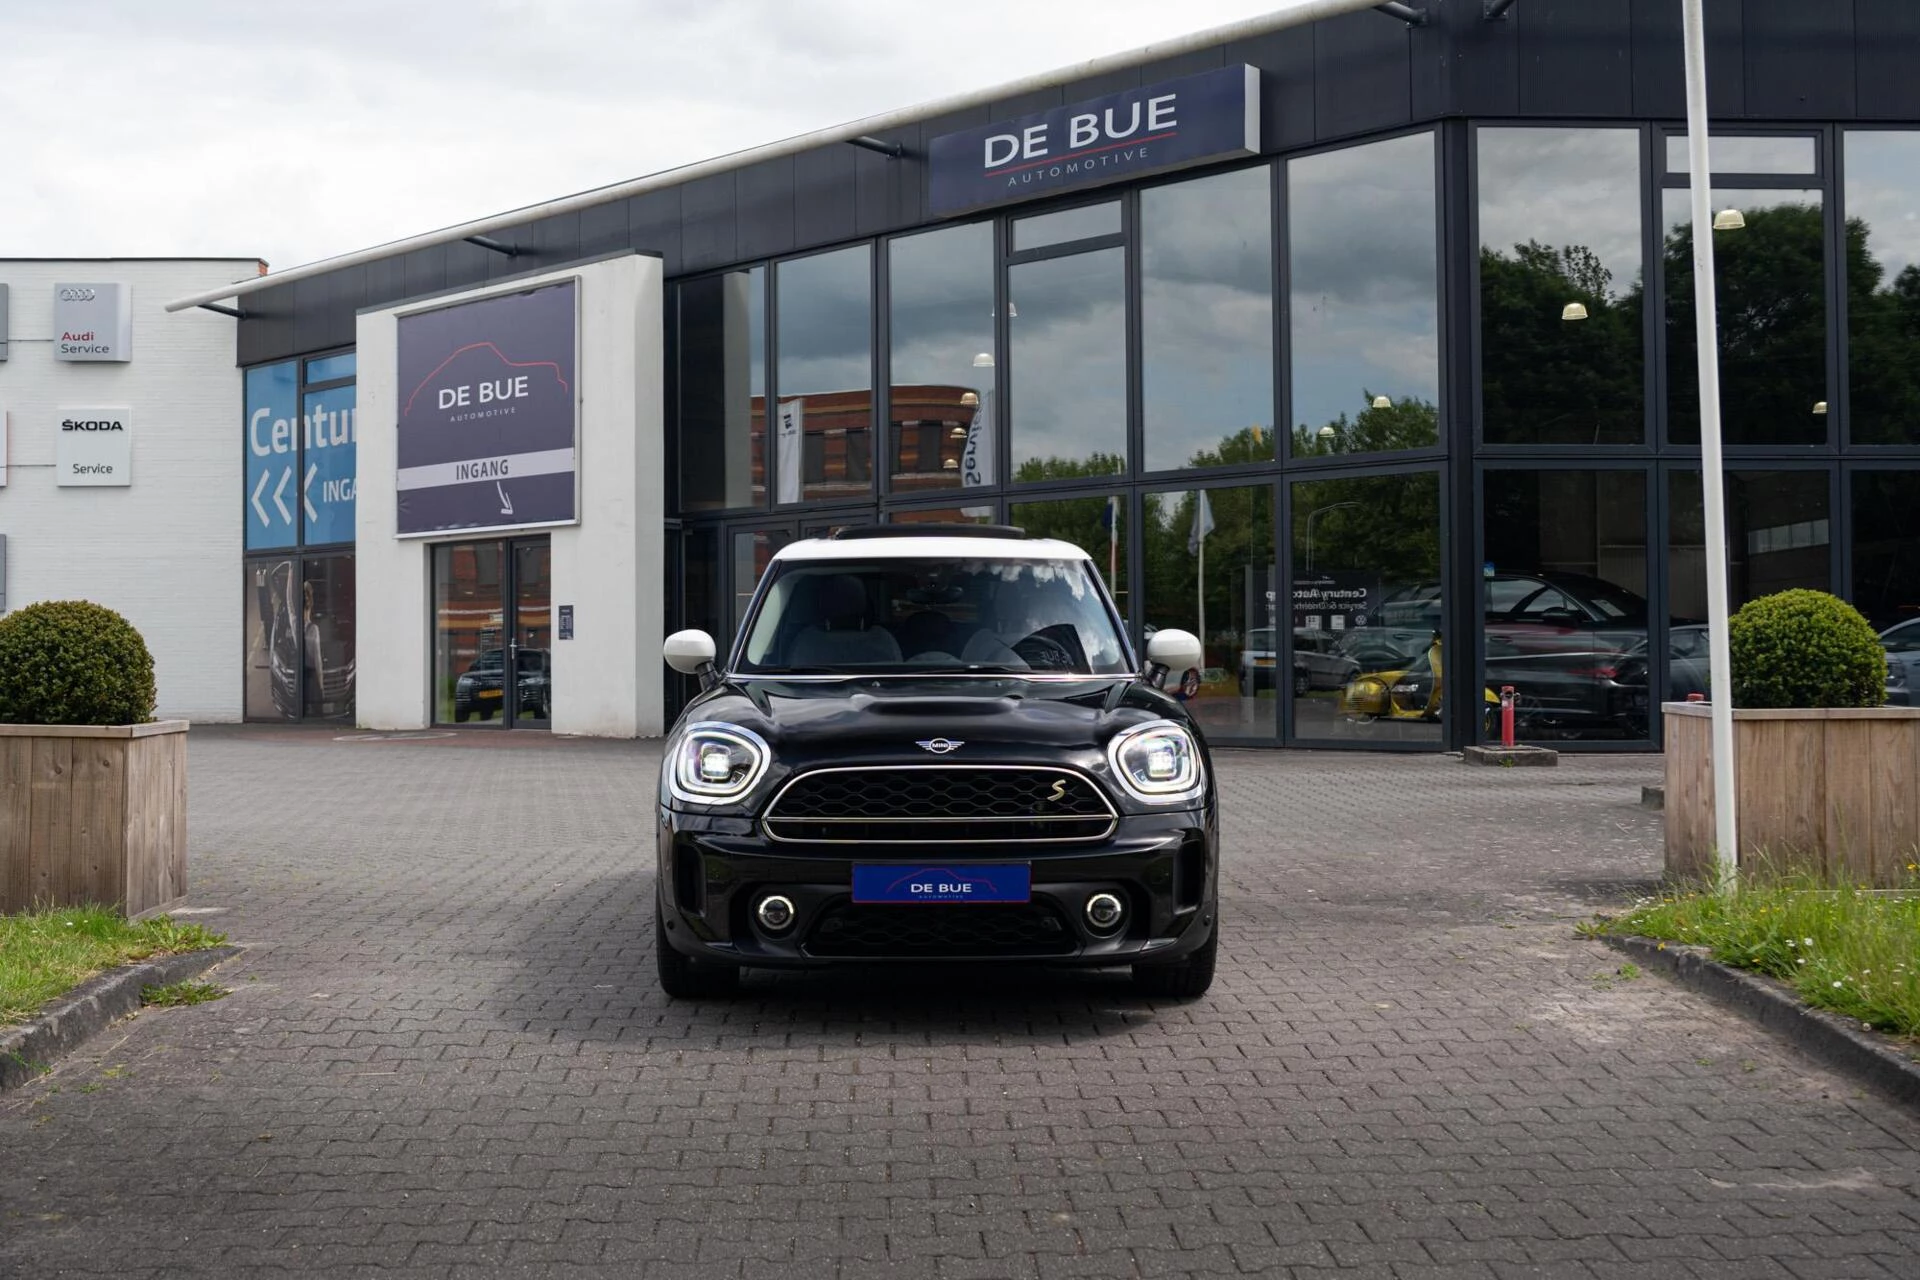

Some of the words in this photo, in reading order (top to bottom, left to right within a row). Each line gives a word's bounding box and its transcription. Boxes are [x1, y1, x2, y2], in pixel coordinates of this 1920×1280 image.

[984, 123, 1049, 169] DE
[1069, 93, 1177, 149] BUE
[1008, 147, 1148, 187] AUTOMOTIVE
[61, 331, 95, 342] Audi
[61, 343, 110, 354] Service
[438, 385, 471, 410] DE
[479, 376, 529, 403] BUE
[450, 406, 516, 422] AUTOMOTIVE
[61, 419, 123, 431] ŠKODA
[72, 463, 113, 474] Service
[456, 459, 509, 480] INGANG
[1047, 779, 1066, 801] S
[910, 883, 933, 893] DE
[939, 883, 973, 893] BUE
